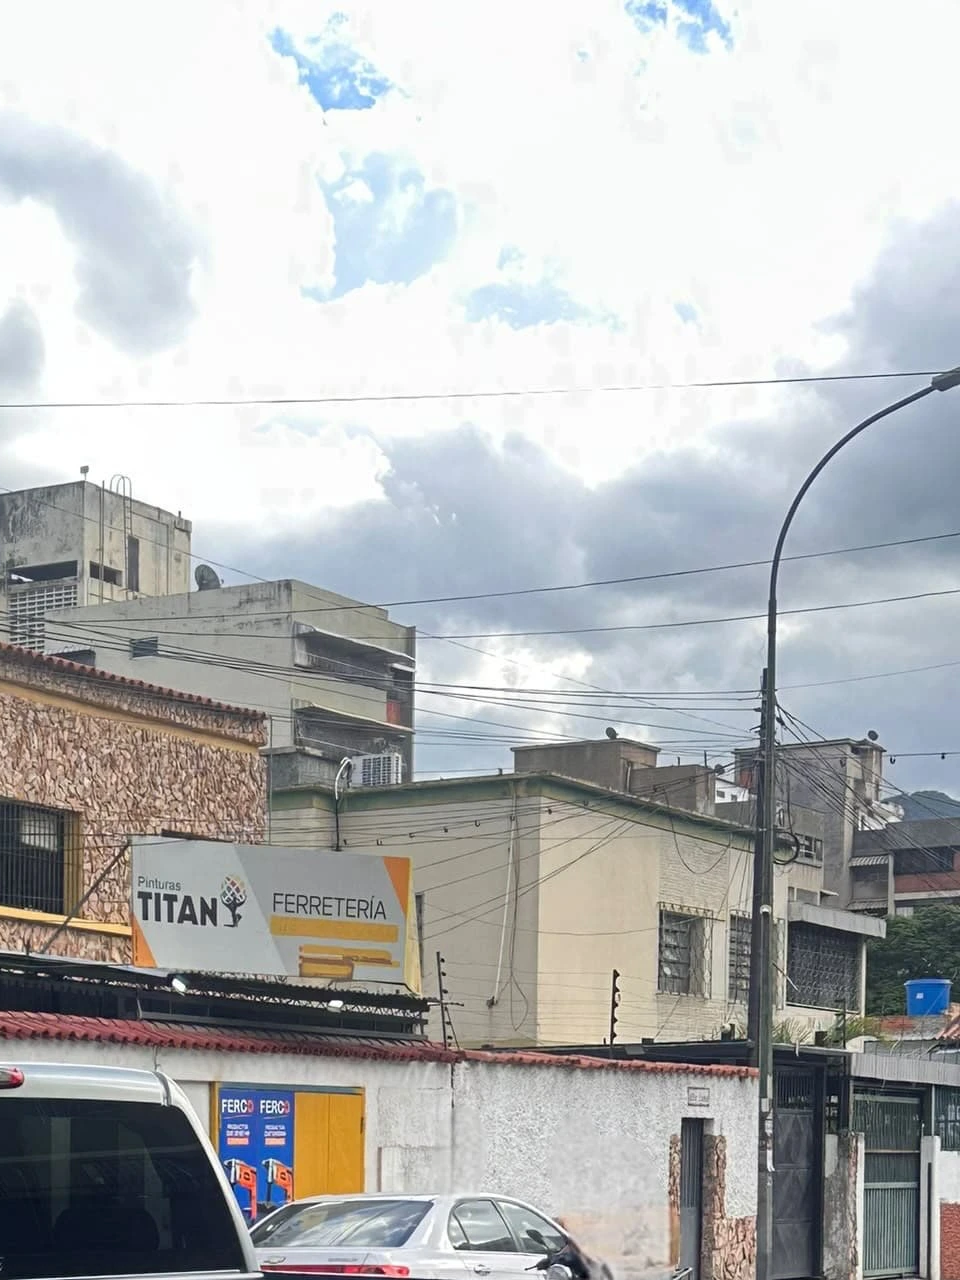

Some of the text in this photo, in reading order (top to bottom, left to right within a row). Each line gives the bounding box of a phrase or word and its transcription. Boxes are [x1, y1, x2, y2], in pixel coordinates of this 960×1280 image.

[137, 876, 181, 891] Pinturas
[137, 891, 218, 927] TITAN
[273, 893, 387, 920] FERRETERÍA
[221, 1098, 254, 1114] FERCO
